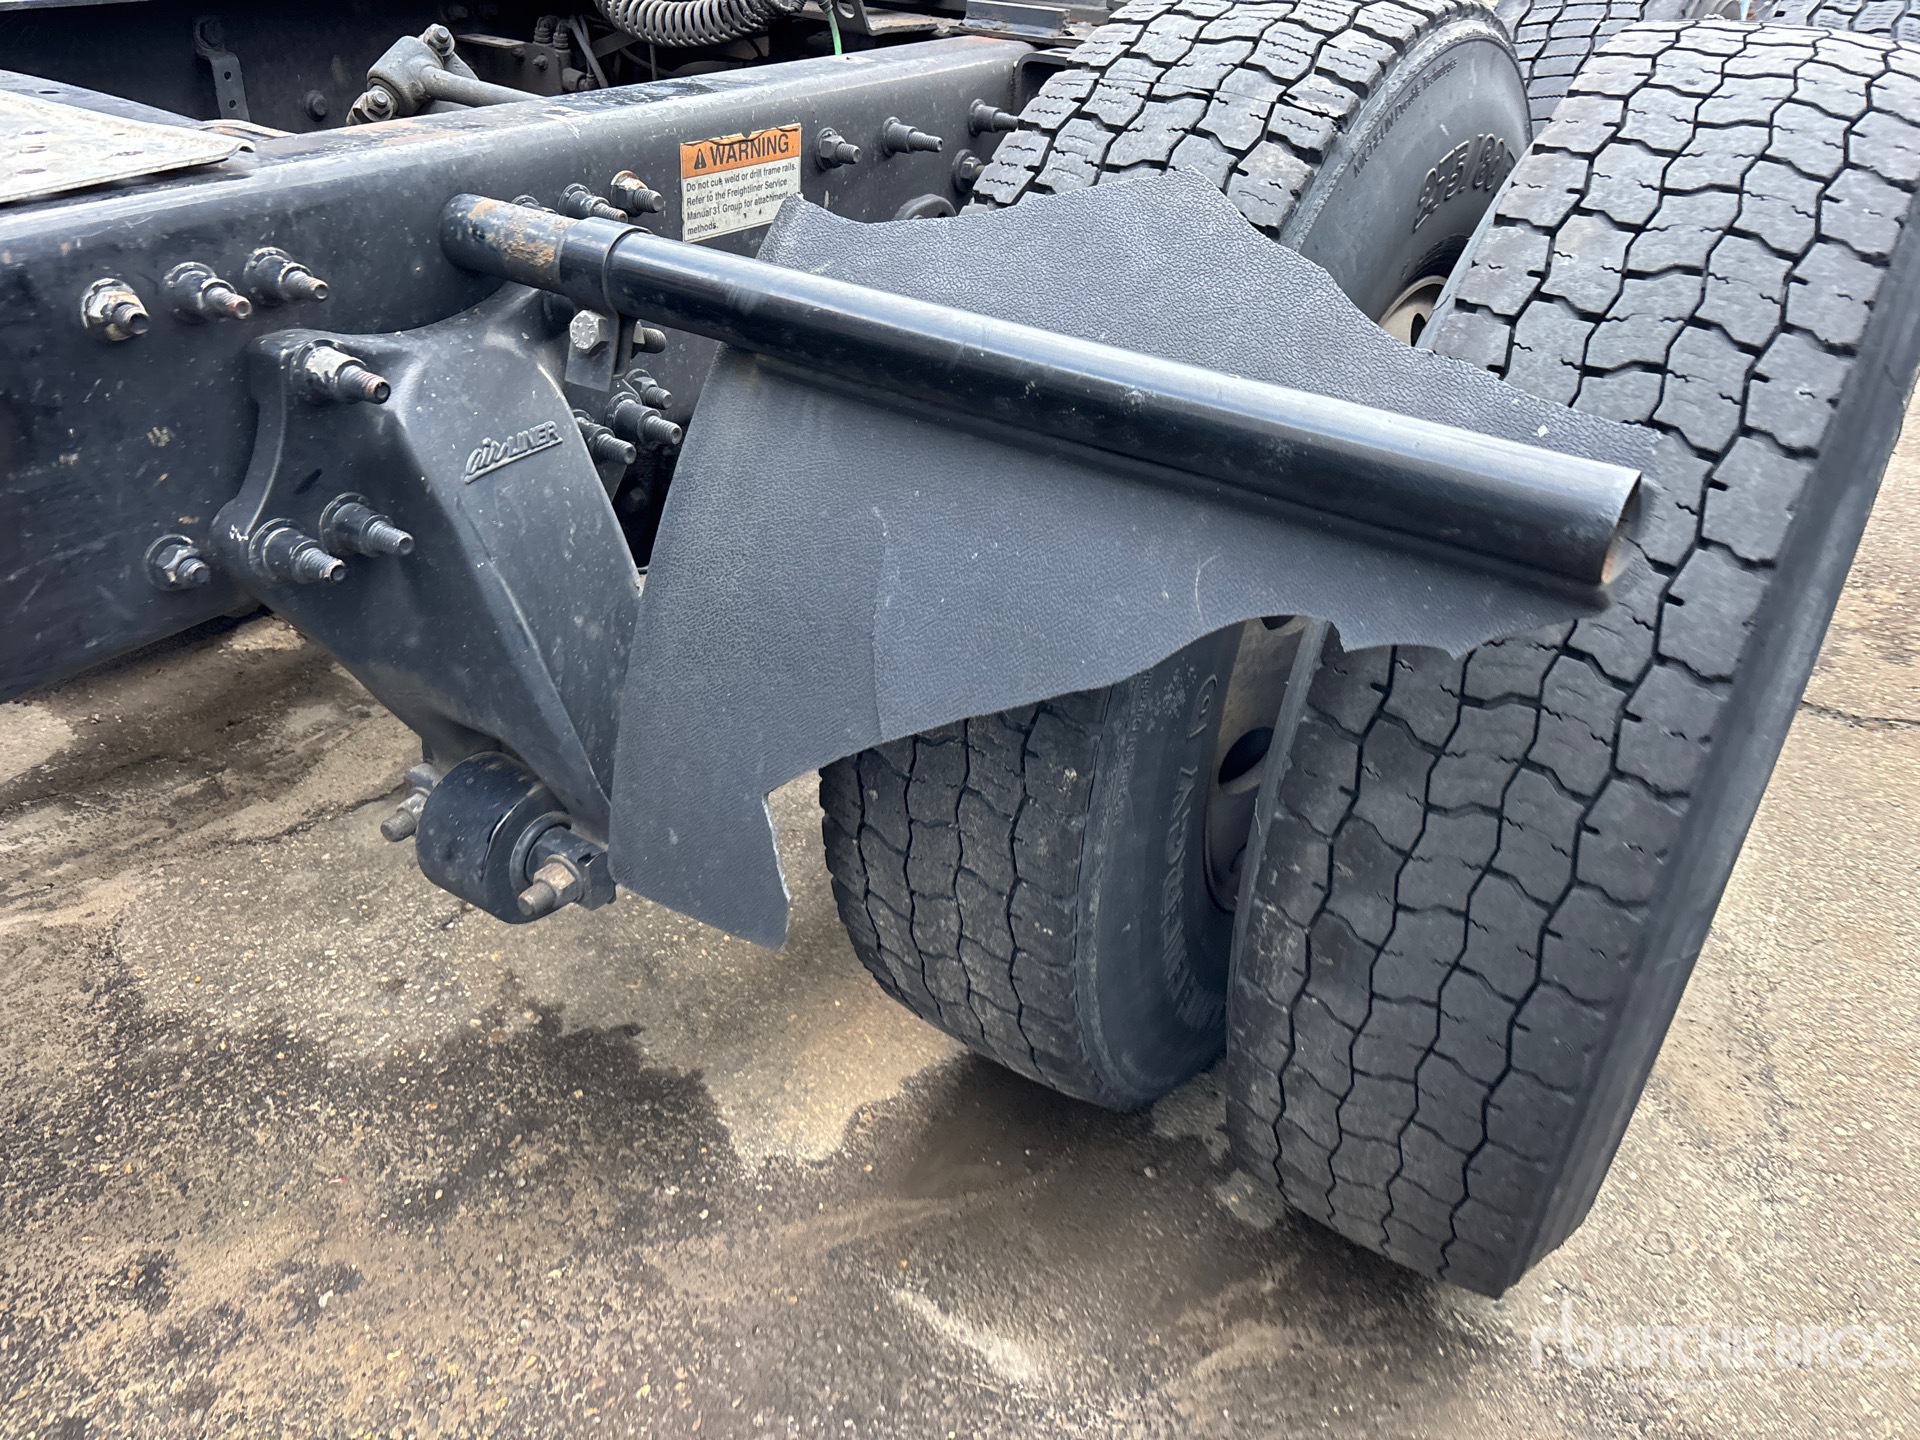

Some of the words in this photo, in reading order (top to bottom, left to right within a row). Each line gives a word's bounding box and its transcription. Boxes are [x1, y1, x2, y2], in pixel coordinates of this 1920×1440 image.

[710, 133, 789, 167] WARNING
[686, 182, 697, 193] Do
[698, 180, 709, 191] not
[725, 173, 740, 184] weld
[741, 172, 749, 181] or
[749, 168, 762, 179] drill
[763, 166, 781, 177] frame
[782, 162, 797, 173] rails.
[686, 194, 705, 207] Refer
[706, 192, 714, 202] to
[715, 190, 726, 200] the
[727, 182, 763, 199] Freightliner
[764, 178, 788, 190] Service
[687, 207, 712, 221] Manual
[712, 206, 721, 216] 31
[722, 201, 743, 214] Group
[744, 199, 753, 208] for
[754, 190, 789, 206] attachment
[687, 221, 719, 236] methods.
